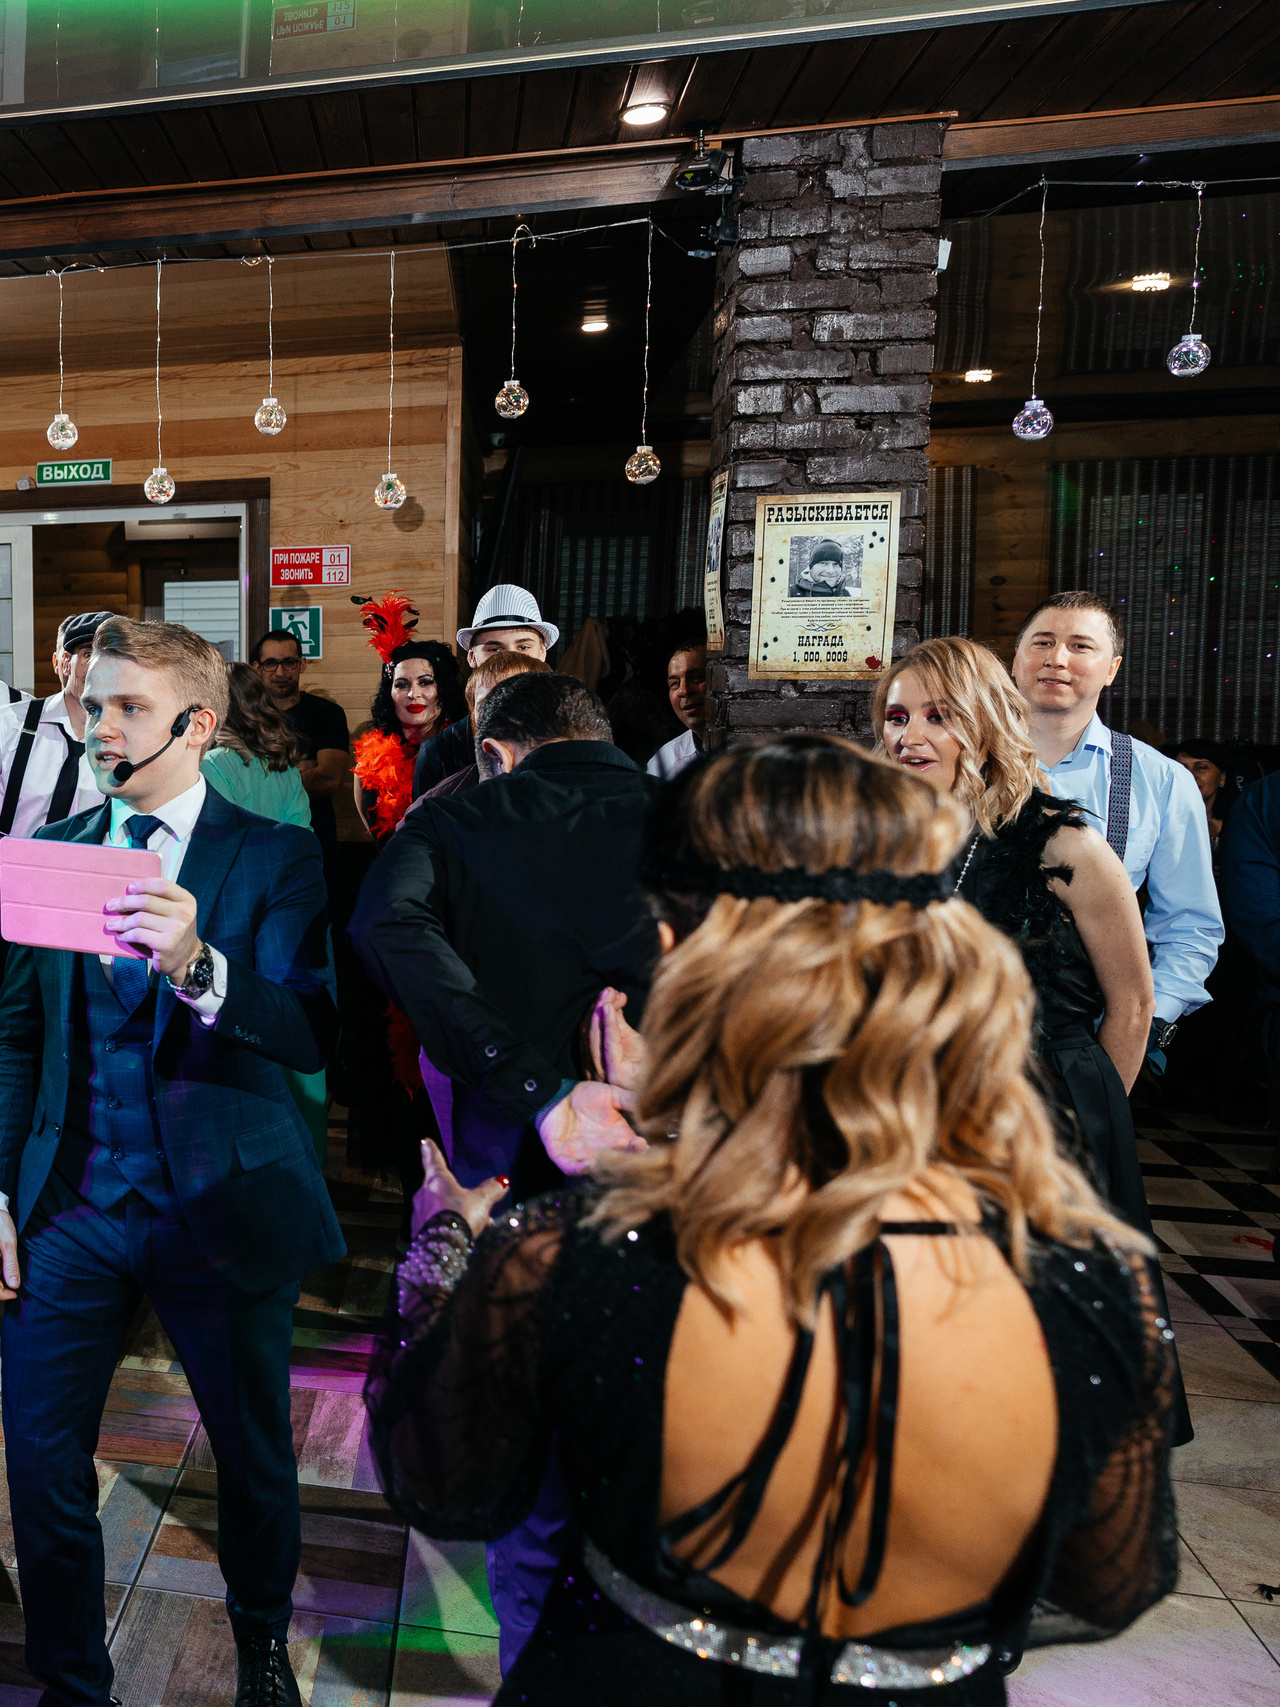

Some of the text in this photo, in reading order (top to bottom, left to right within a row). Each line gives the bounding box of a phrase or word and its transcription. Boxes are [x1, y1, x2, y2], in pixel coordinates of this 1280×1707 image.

[43, 464, 104, 480] ВЫХОД
[766, 504, 889, 522] РАЗЫСКИВАЕТСЯ
[274, 552, 320, 565] ПРИ ПОЖАРЕ
[329, 553, 341, 564] 01
[280, 568, 314, 580] ЗВОНИТЬ
[326, 571, 344, 582] 112
[797, 635, 844, 648] НАГРАДА
[826, 650, 848, 663] 000$
